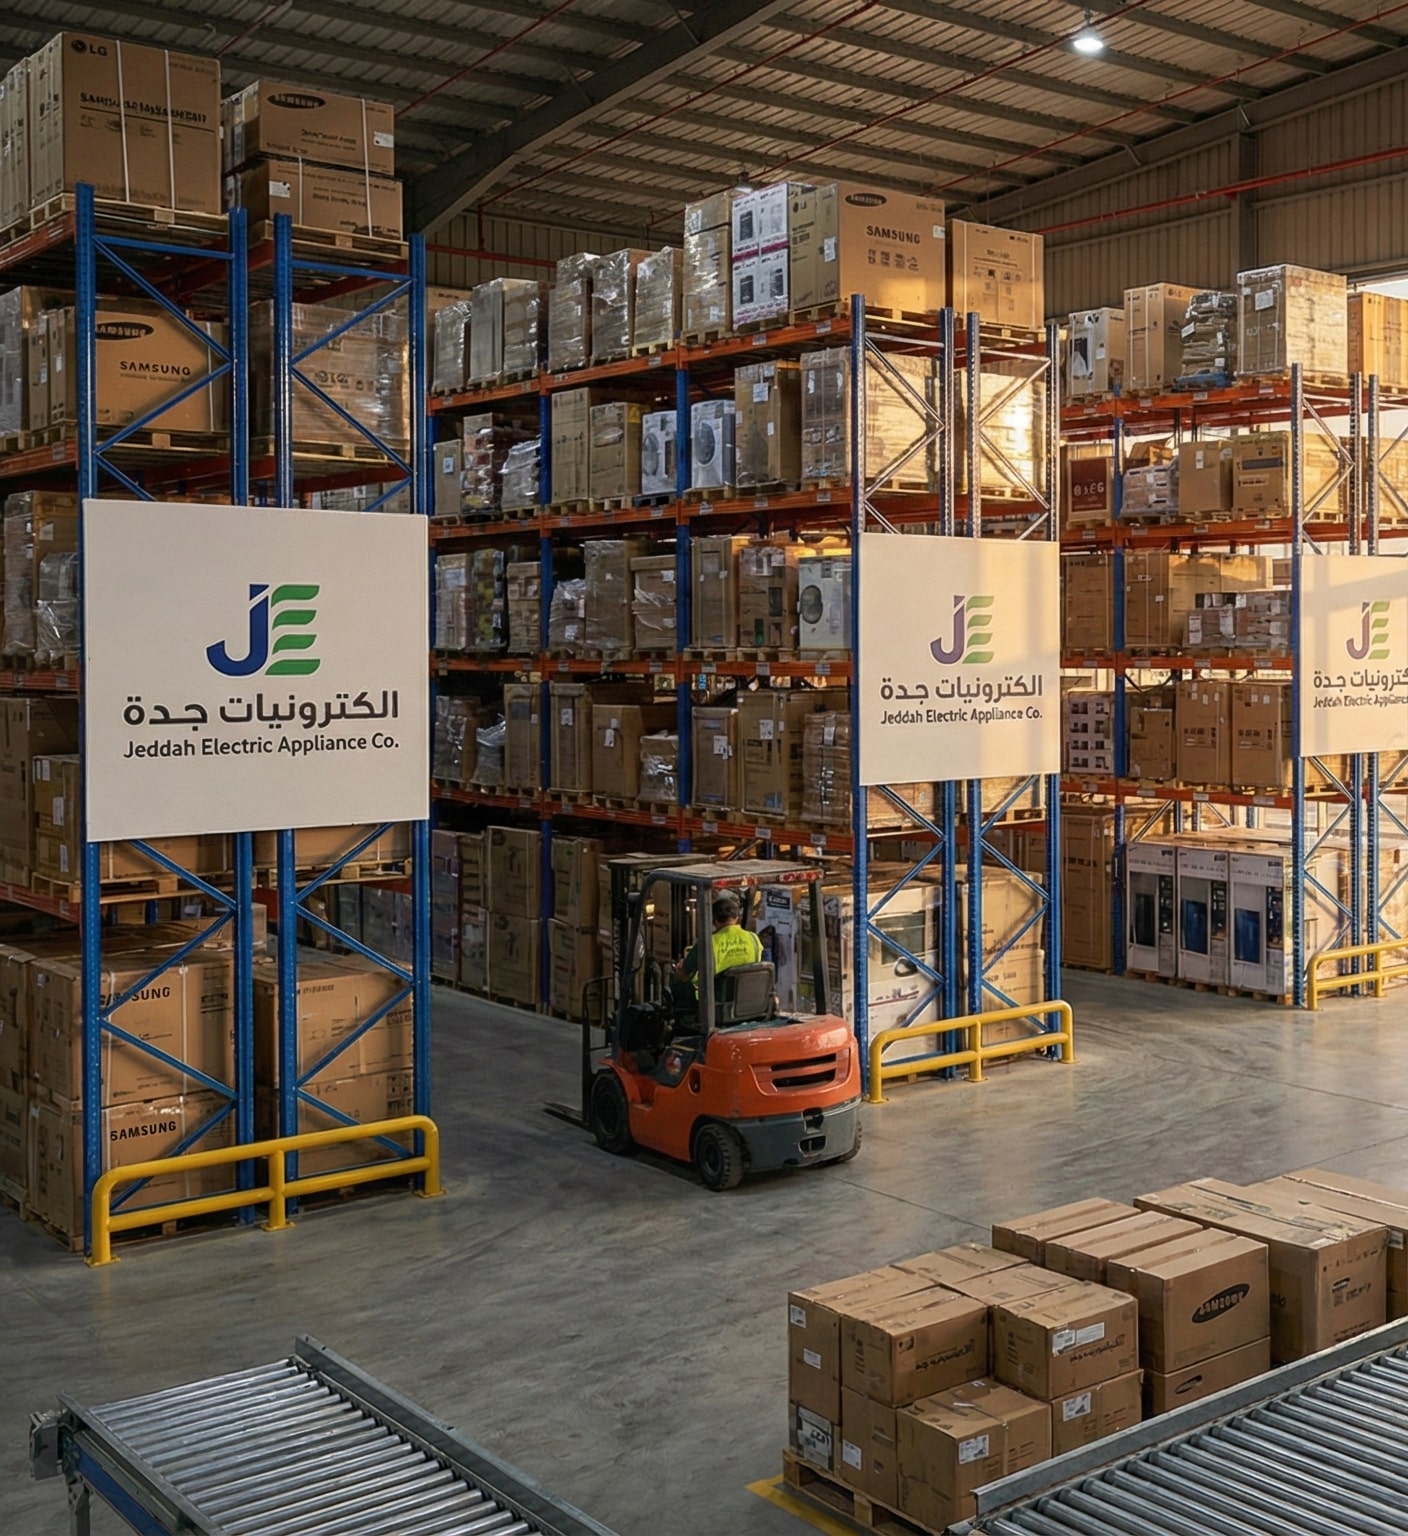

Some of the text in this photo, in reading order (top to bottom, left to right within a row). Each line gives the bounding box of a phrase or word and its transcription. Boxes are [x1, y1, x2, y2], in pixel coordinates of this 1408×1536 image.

[89, 44, 108, 57] LG
[866, 224, 921, 244] SAMSUNG
[95, 325, 147, 338] AMSUNG
[880, 675, 1043, 705] الكترونيات جدة
[1313, 670, 1346, 693] جدة
[123, 690, 399, 731] الكترونيات جدة
[880, 706, 1043, 724] Jeddah Electric Appliance Co.
[123, 732, 399, 759] Jeddah Electric Appliance Co.
